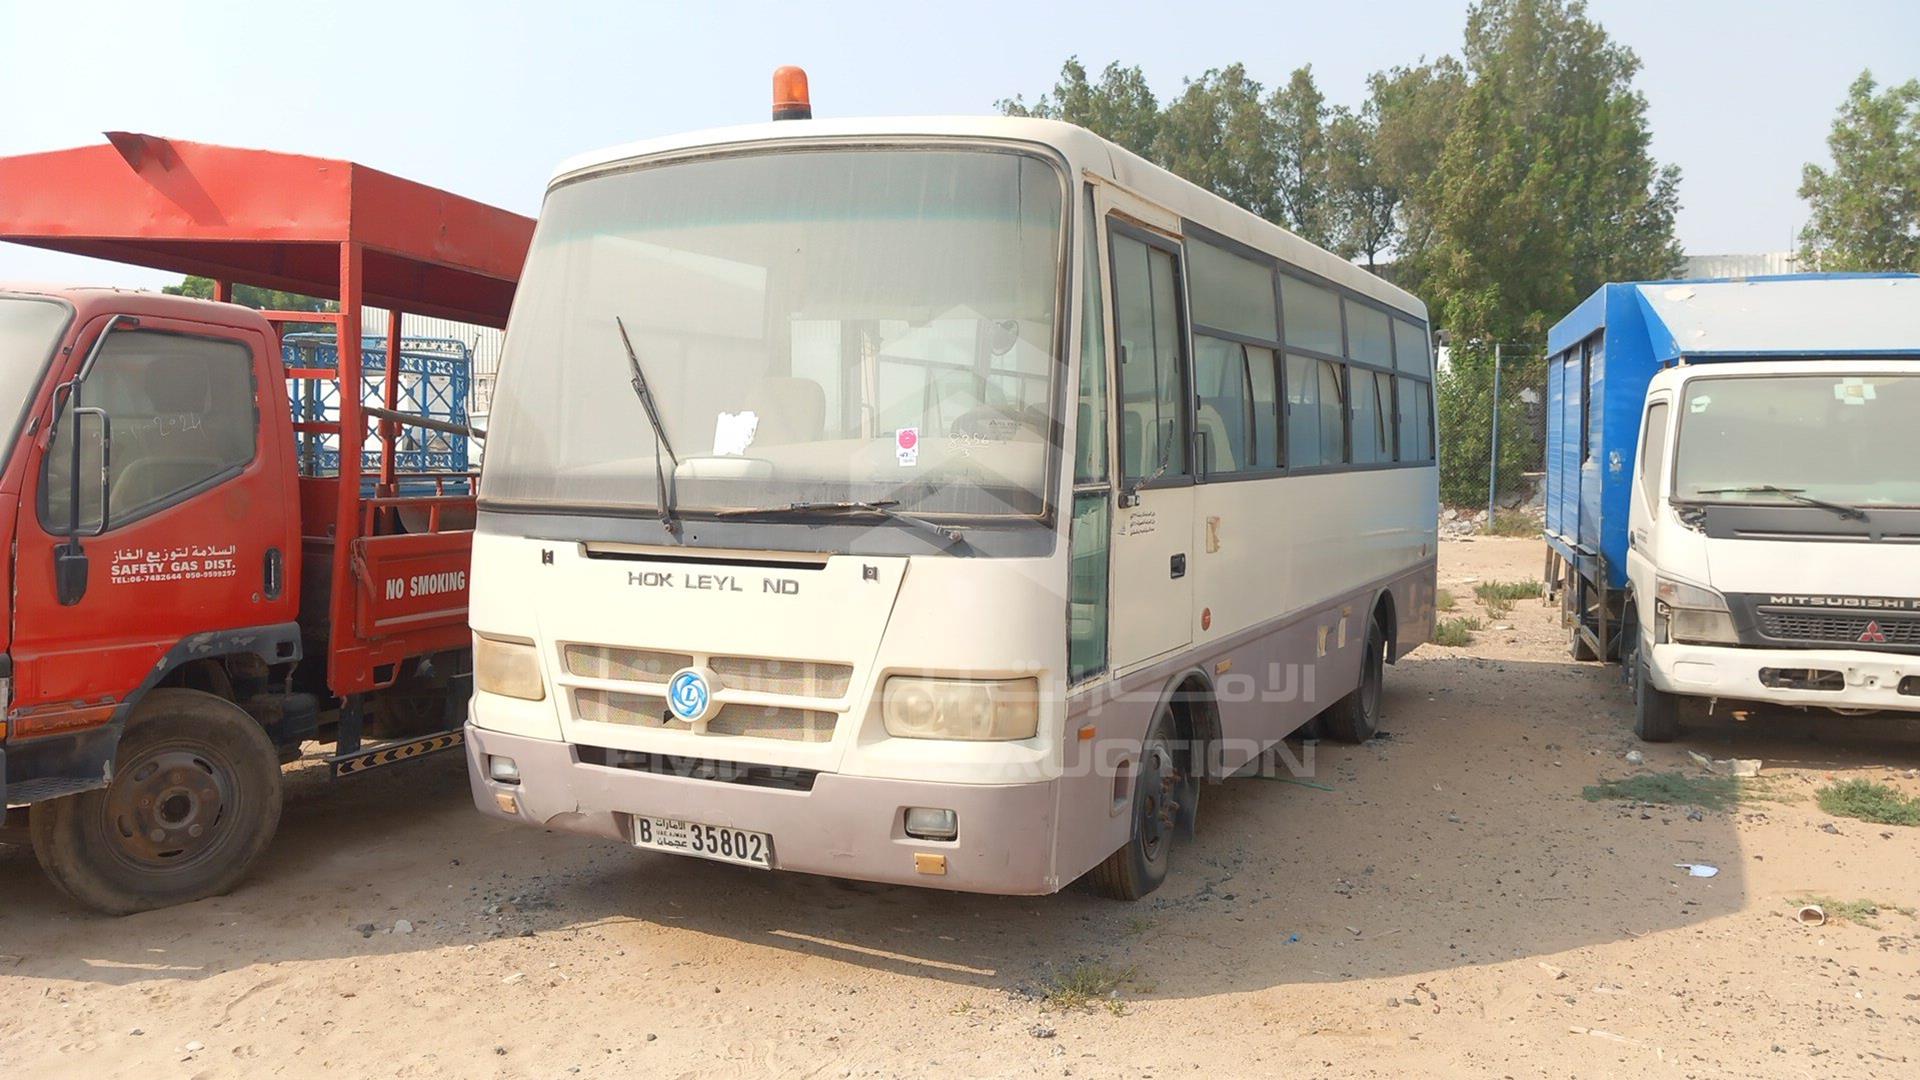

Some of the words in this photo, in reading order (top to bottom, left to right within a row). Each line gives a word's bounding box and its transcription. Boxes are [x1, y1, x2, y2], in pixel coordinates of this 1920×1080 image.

[112, 549, 143, 564] الغاز
[146, 547, 189, 562] لتوزيع
[192, 545, 236, 557] السلامة
[111, 563, 165, 576] SAFETY
[171, 561, 199, 573] GAS
[204, 560, 236, 570] DIST.
[386, 578, 404, 600] NO
[410, 570, 465, 597] SMOKING
[628, 571, 674, 587] HOK
[1770, 595, 1905, 608] MITSUBISHI
[640, 819, 652, 843] B
[690, 824, 763, 862] 35802
[657, 837, 688, 849] عجمان
